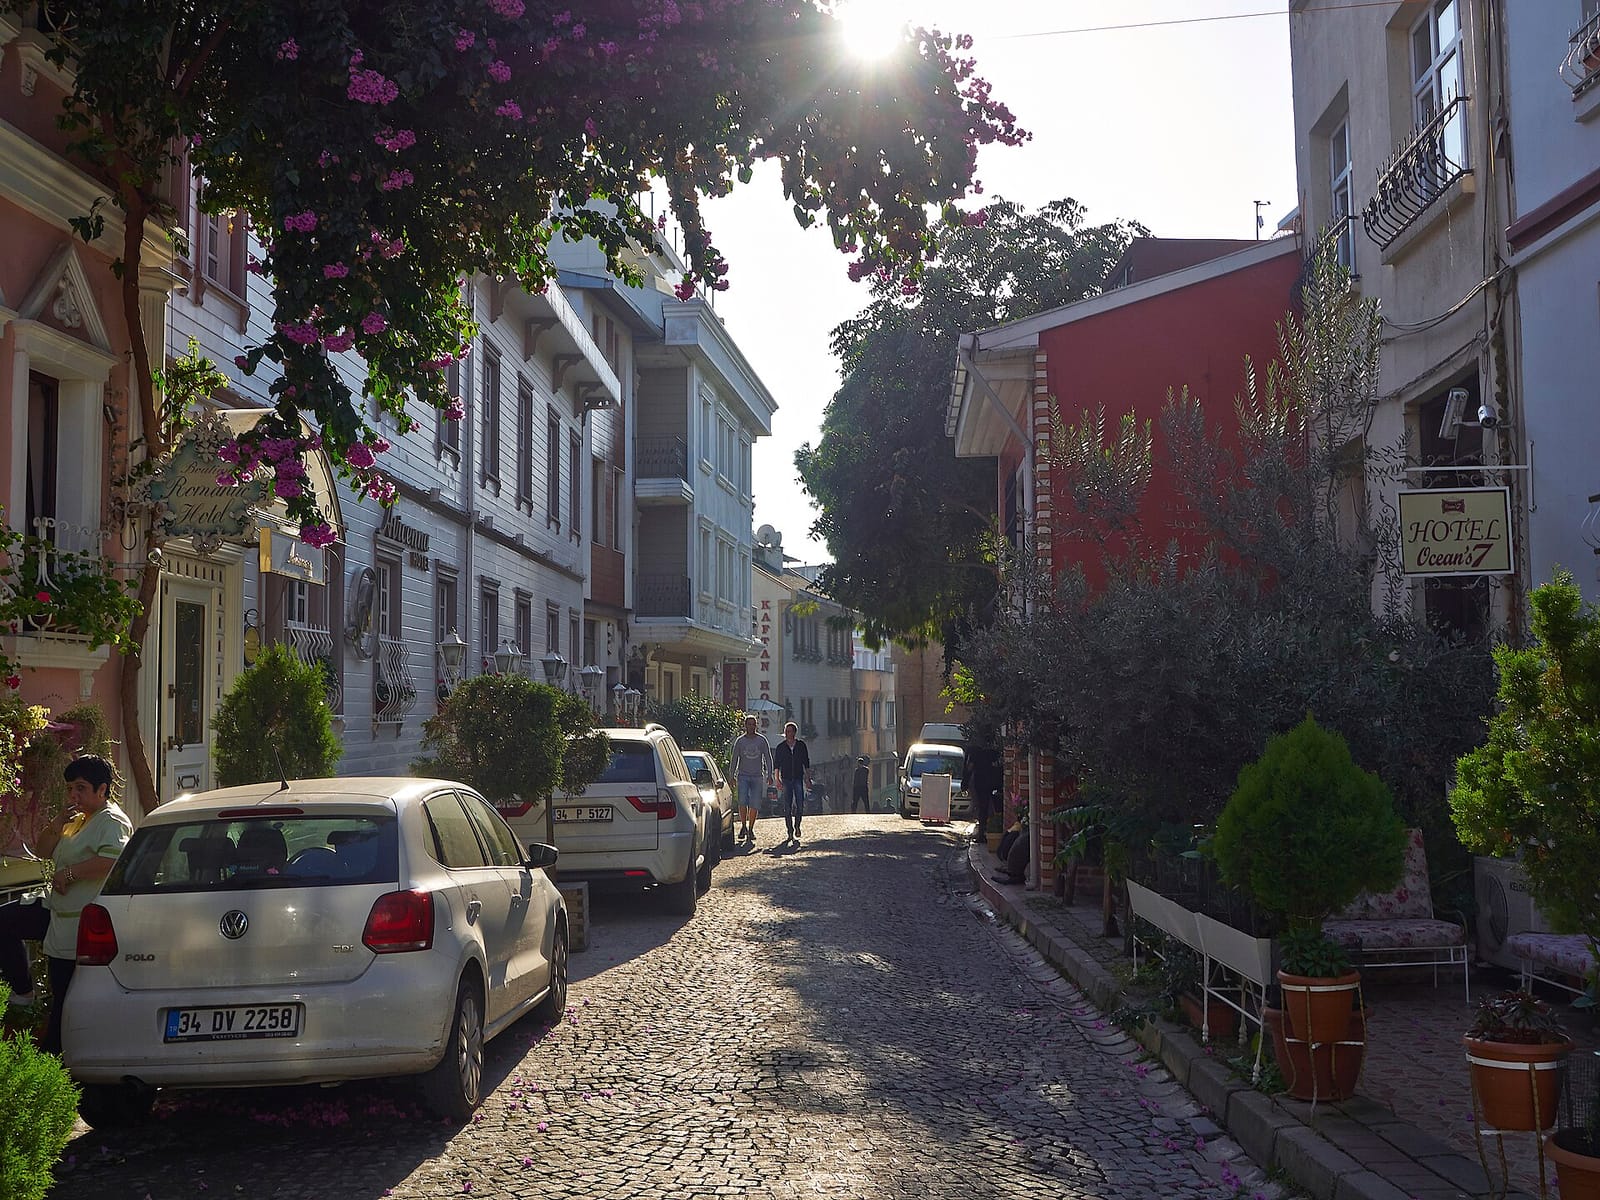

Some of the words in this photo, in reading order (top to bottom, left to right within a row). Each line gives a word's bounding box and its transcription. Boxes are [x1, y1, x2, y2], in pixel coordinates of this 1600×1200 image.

[164, 476, 250, 498] Romantic
[178, 499, 233, 524] Hotel
[1408, 518, 1500, 543] HOTEL
[760, 600, 770, 672] KAFTAN
[760, 681, 770, 734] HOE
[556, 809, 568, 820] 34
[576, 808, 583, 819] P
[589, 808, 610, 819] 5127
[125, 953, 155, 962] POLO
[178, 1012, 201, 1033] 34
[211, 1010, 236, 1032] DV
[243, 1008, 293, 1031] 2258
